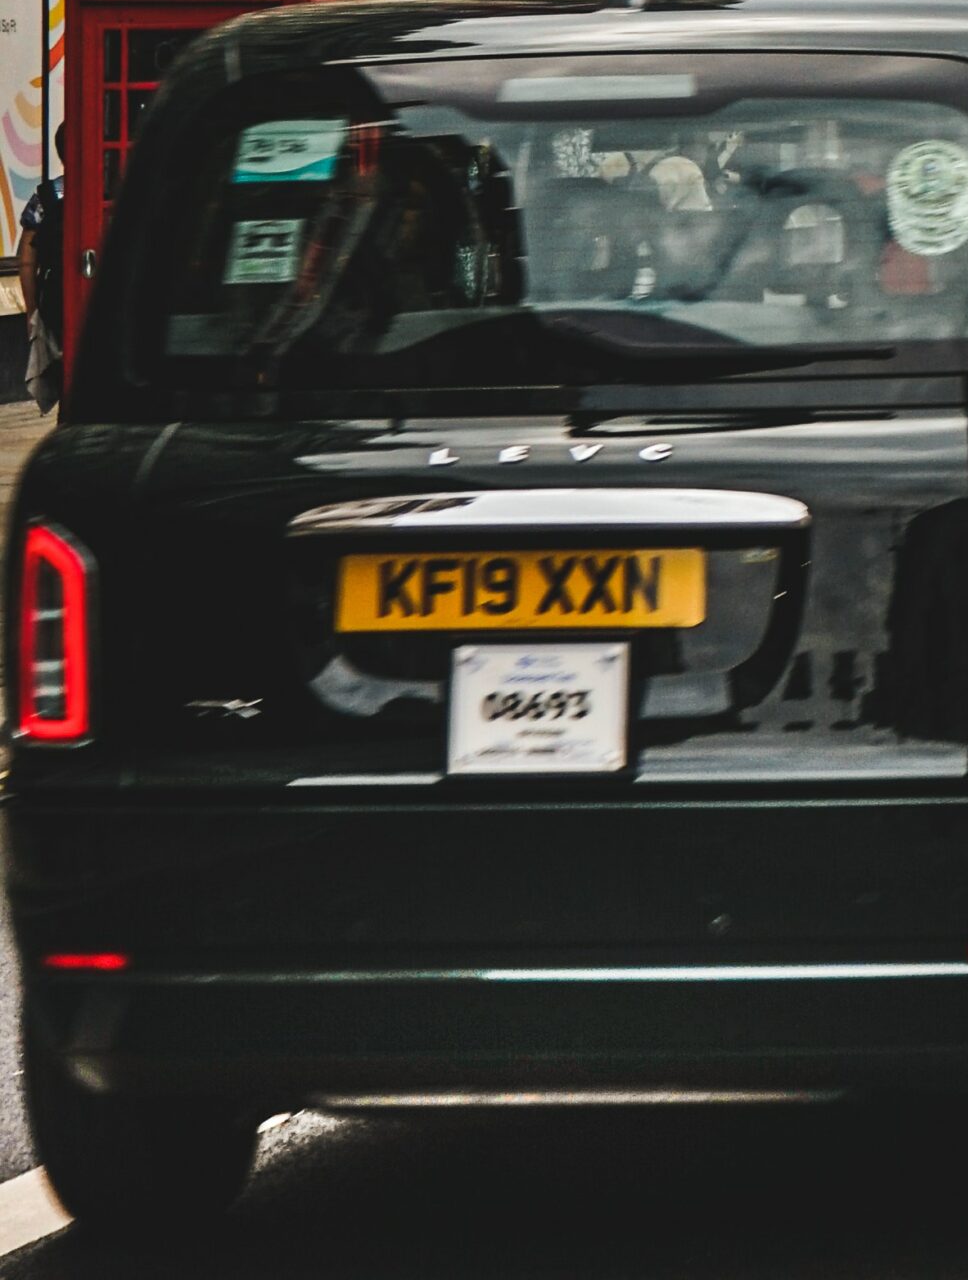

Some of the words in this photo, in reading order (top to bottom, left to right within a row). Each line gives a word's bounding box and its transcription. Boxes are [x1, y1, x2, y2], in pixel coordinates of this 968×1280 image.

[428, 443, 674, 466] LEVC
[376, 556, 521, 618] KF19
[534, 554, 661, 615] XXN
[480, 690, 591, 721] 08693
